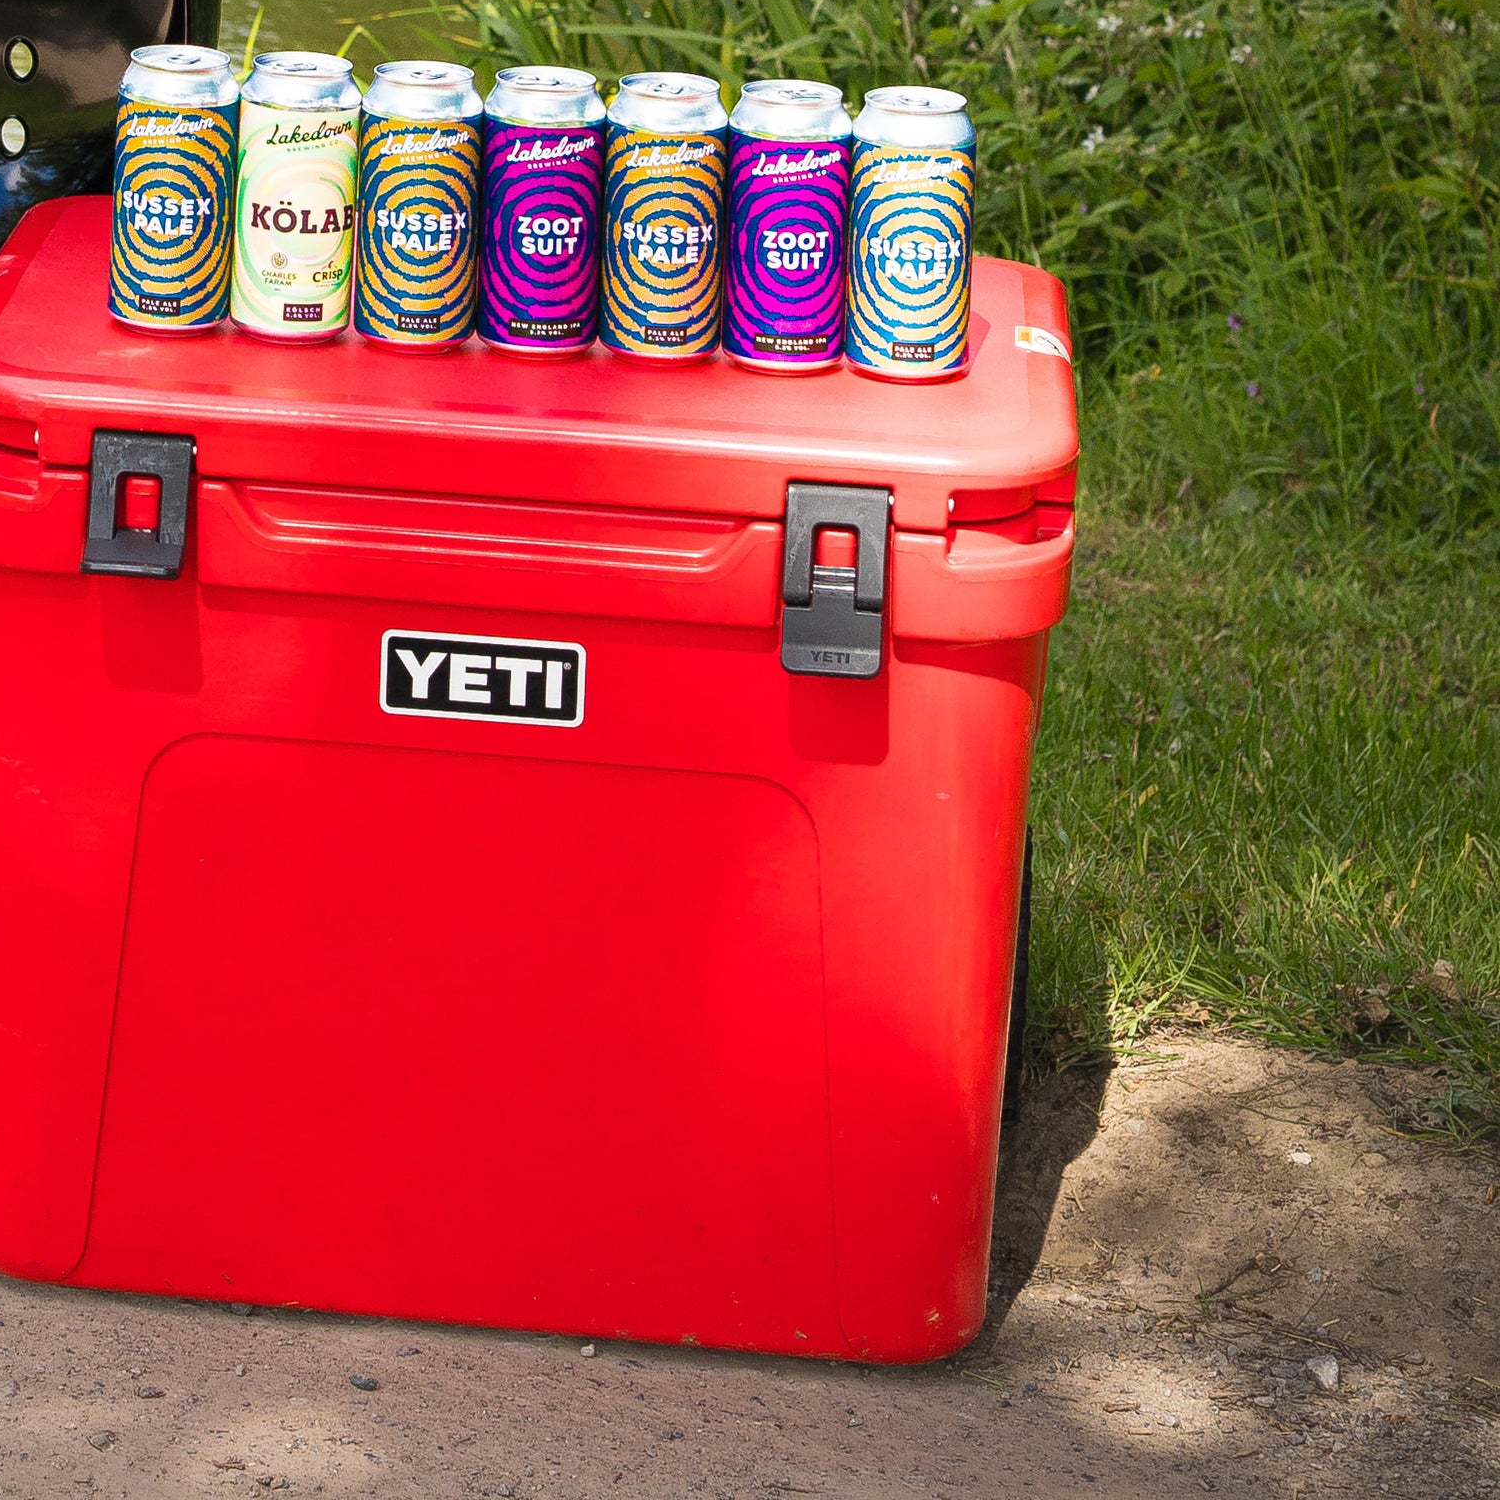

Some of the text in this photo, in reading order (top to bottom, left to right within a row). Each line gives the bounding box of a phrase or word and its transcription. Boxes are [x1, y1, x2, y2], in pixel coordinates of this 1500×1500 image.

[126, 114, 215, 138] Lakedown
[266, 120, 352, 145] Lakedown
[143, 136, 182, 145] BREWING
[287, 143, 326, 152] BREWING
[380, 130, 470, 155] Lakedown
[506, 136, 595, 162] Lakedown
[400, 154, 441, 162] BREWING
[528, 160, 567, 169] BREWING
[626, 142, 716, 167] Lakedown
[752, 150, 842, 176] Lakedown
[646, 165, 686, 175] BREWING
[772, 173, 813, 184] BREWING
[872, 156, 963, 184] Lakedown
[122, 190, 211, 216] SUSSEX
[134, 214, 194, 236] PALE
[251, 201, 353, 234] KÖLAB
[376, 209, 466, 232] SUSSEX
[517, 216, 583, 235] ZOOT
[392, 232, 452, 251] PALE
[623, 222, 713, 244] SUSSEX
[763, 230, 829, 250] ZOOT
[522, 236, 578, 256] SUIT
[638, 244, 699, 264] PALE
[869, 237, 961, 260] SUSSEX
[767, 251, 824, 270] SUIT
[884, 260, 947, 280] PALE
[261, 269, 297, 280] CHARLES
[312, 269, 343, 283] CRISP
[141, 298, 160, 306] PALE
[511, 321, 529, 329] NEW
[755, 336, 774, 344] NEW
[894, 345, 914, 353] PALE
[810, 650, 850, 664] YETI
[395, 649, 563, 709] YETI
